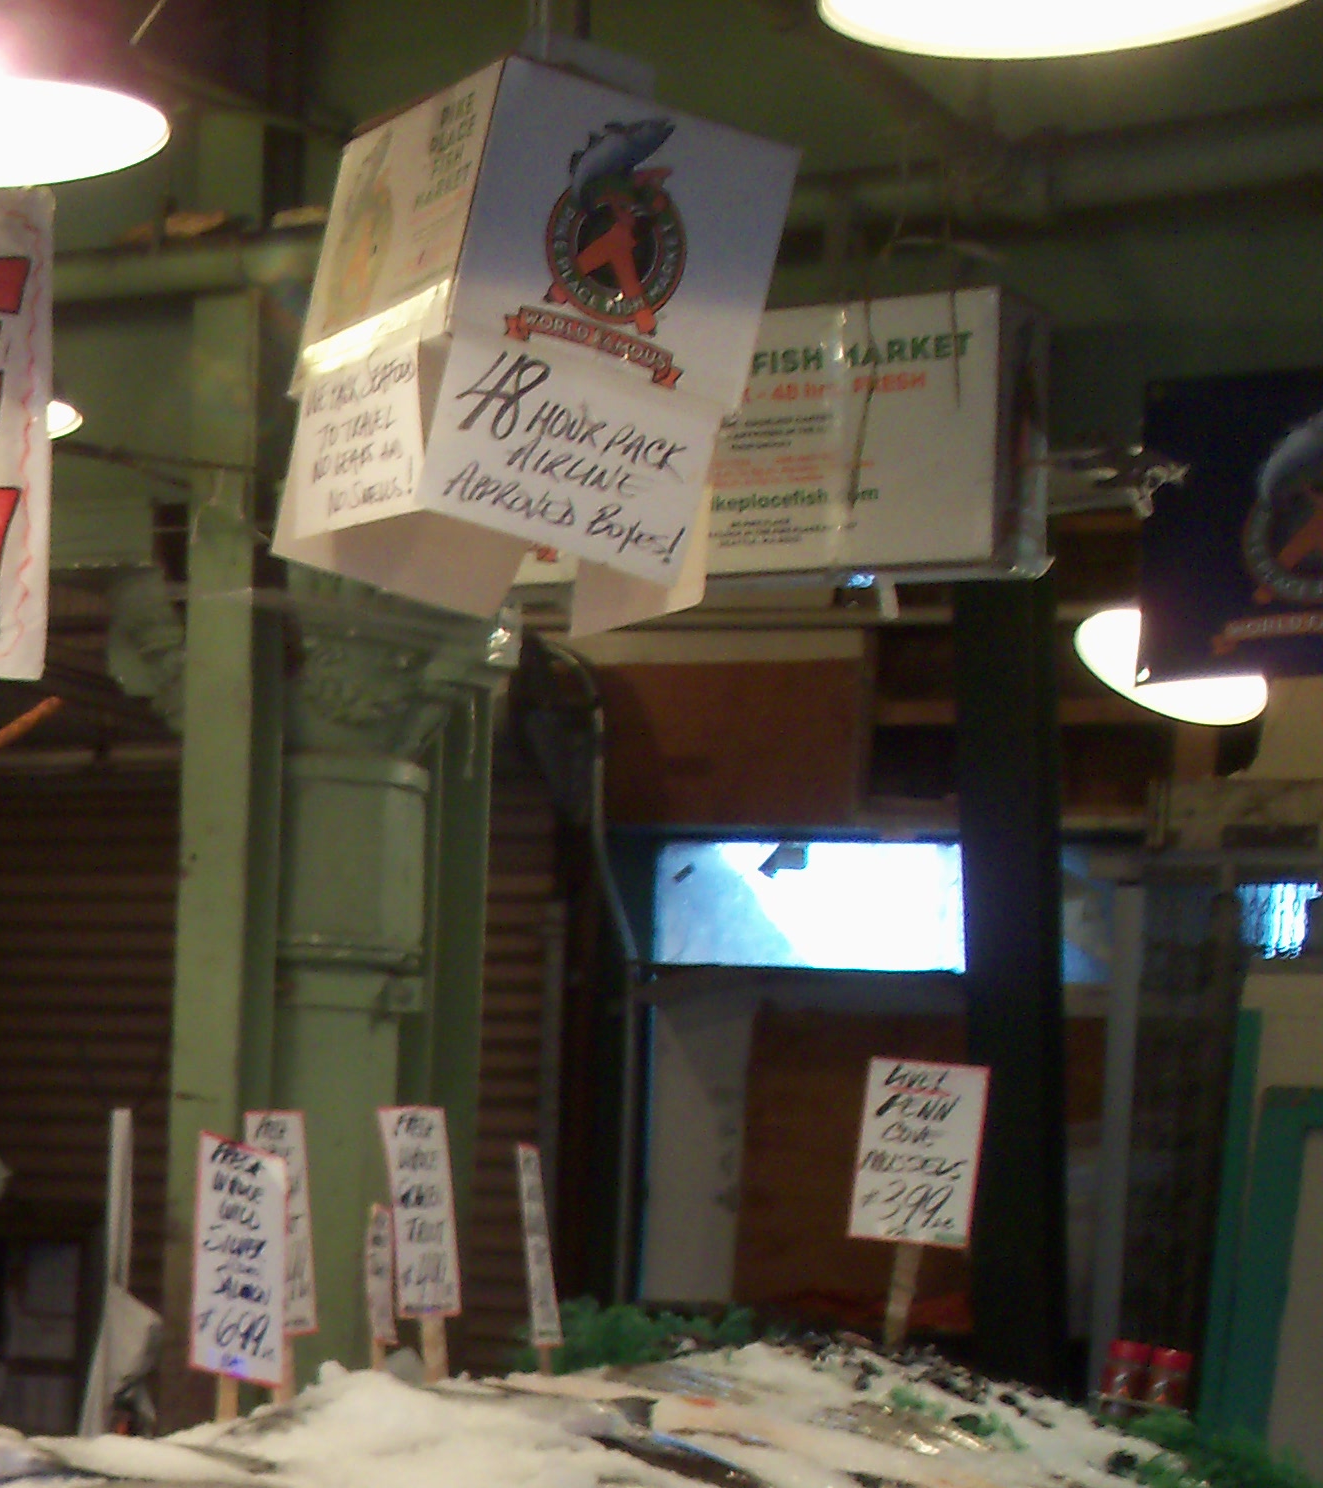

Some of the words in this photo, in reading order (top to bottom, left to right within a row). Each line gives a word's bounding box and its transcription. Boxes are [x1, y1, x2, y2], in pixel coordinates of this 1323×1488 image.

[753, 347, 824, 376] FISH
[457, 351, 550, 441] 48
[606, 424, 686, 475] PACK
[443, 458, 576, 528] APPROVED
[507, 435, 643, 498] AIRLINE
